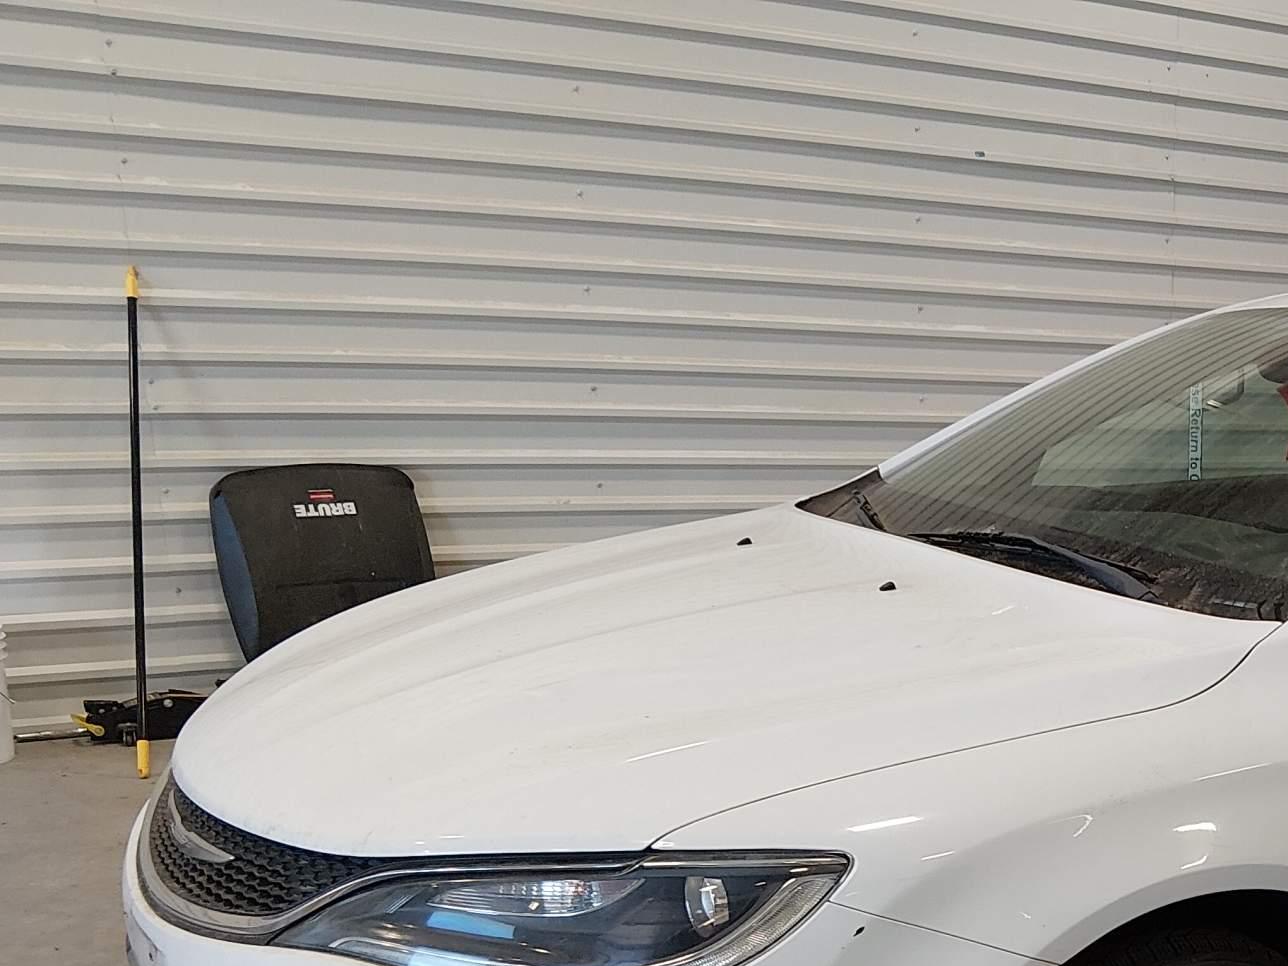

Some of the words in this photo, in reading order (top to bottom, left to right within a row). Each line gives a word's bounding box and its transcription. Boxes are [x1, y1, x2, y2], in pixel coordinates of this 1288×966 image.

[1190, 408, 1201, 453] Return
[1190, 457, 1199, 470] to
[293, 502, 357, 517] BRUTE
